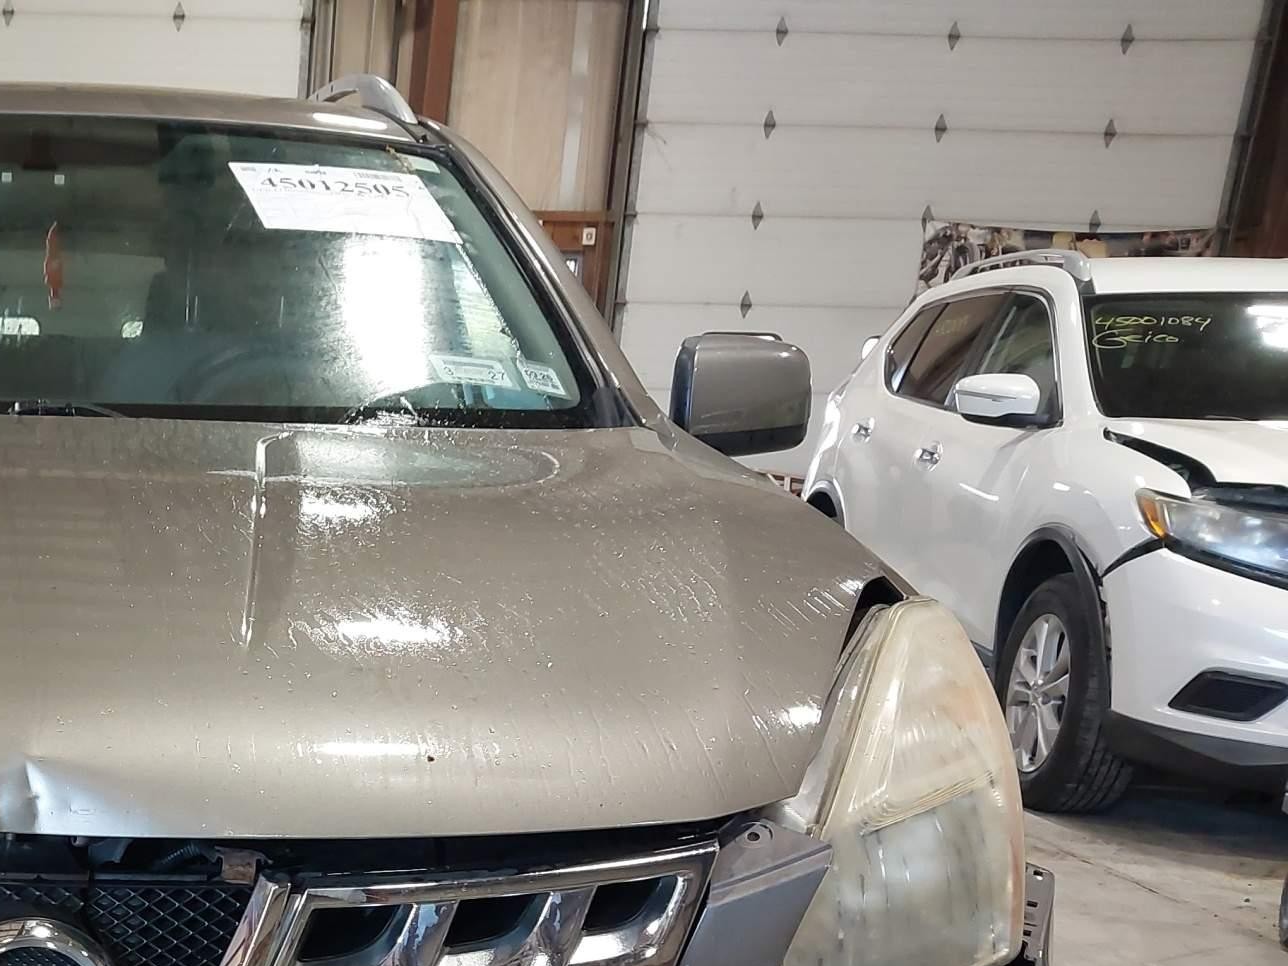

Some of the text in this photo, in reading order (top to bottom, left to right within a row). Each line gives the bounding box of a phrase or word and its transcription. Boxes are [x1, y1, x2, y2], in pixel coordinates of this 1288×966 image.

[260, 177, 410, 197] 45012505
[1094, 315, 1213, 332] 45001084
[487, 370, 505, 380] 27
